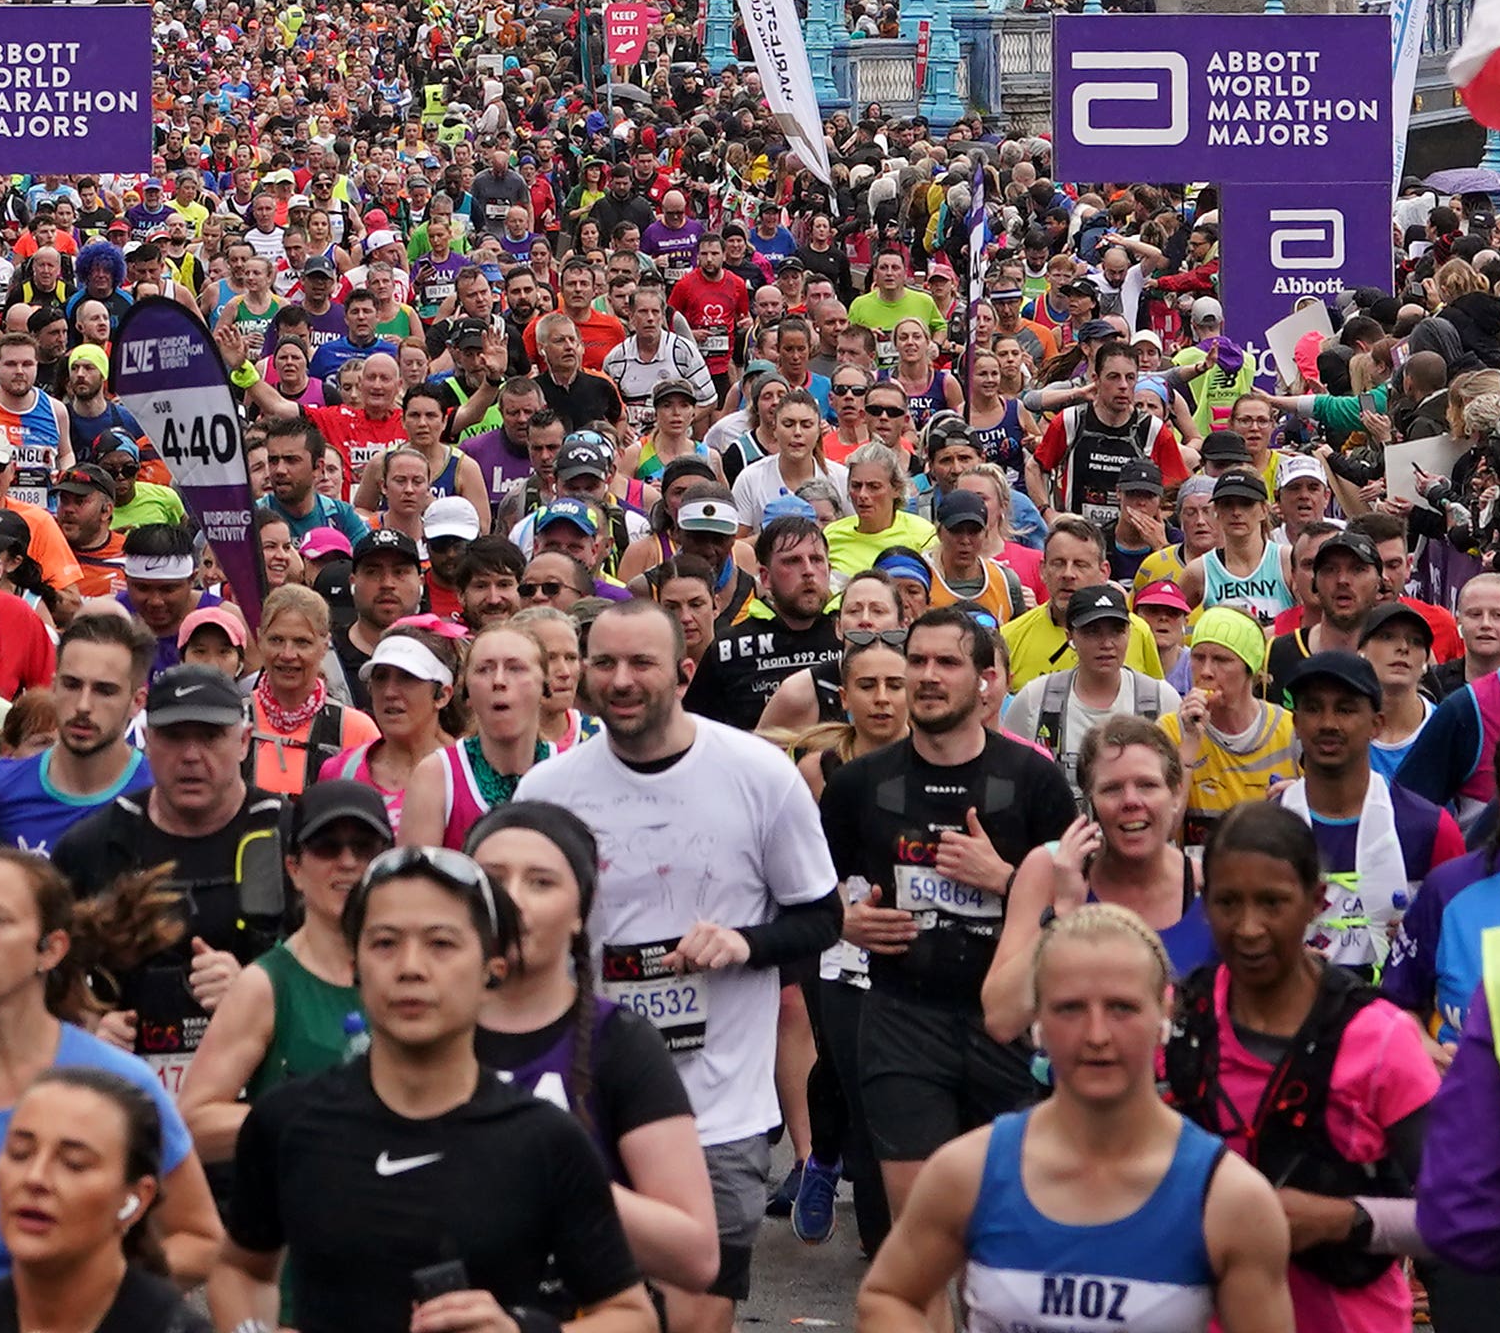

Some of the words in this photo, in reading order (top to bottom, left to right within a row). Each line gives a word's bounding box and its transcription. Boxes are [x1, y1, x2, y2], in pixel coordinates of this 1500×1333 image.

[611, 11, 638, 21] KEEP
[611, 26, 639, 36] LEFT!
[1206, 51, 1320, 73] ABBOTT
[1206, 75, 1311, 97] WORLD
[1207, 100, 1379, 121] MARATHON
[1207, 124, 1329, 146] MAJORS
[1273, 276, 1345, 294] Abbott
[1247, 341, 1278, 377] tc
[153, 401, 172, 414] SUB
[162, 414, 237, 466] 4:40
[1215, 580, 1277, 601] JENNY
[718, 633, 775, 662] BEN
[756, 655, 791, 671] Team
[793, 651, 816, 664] 999
[910, 876, 984, 909] 59864
[1040, 1277, 1130, 1323] MOZ
